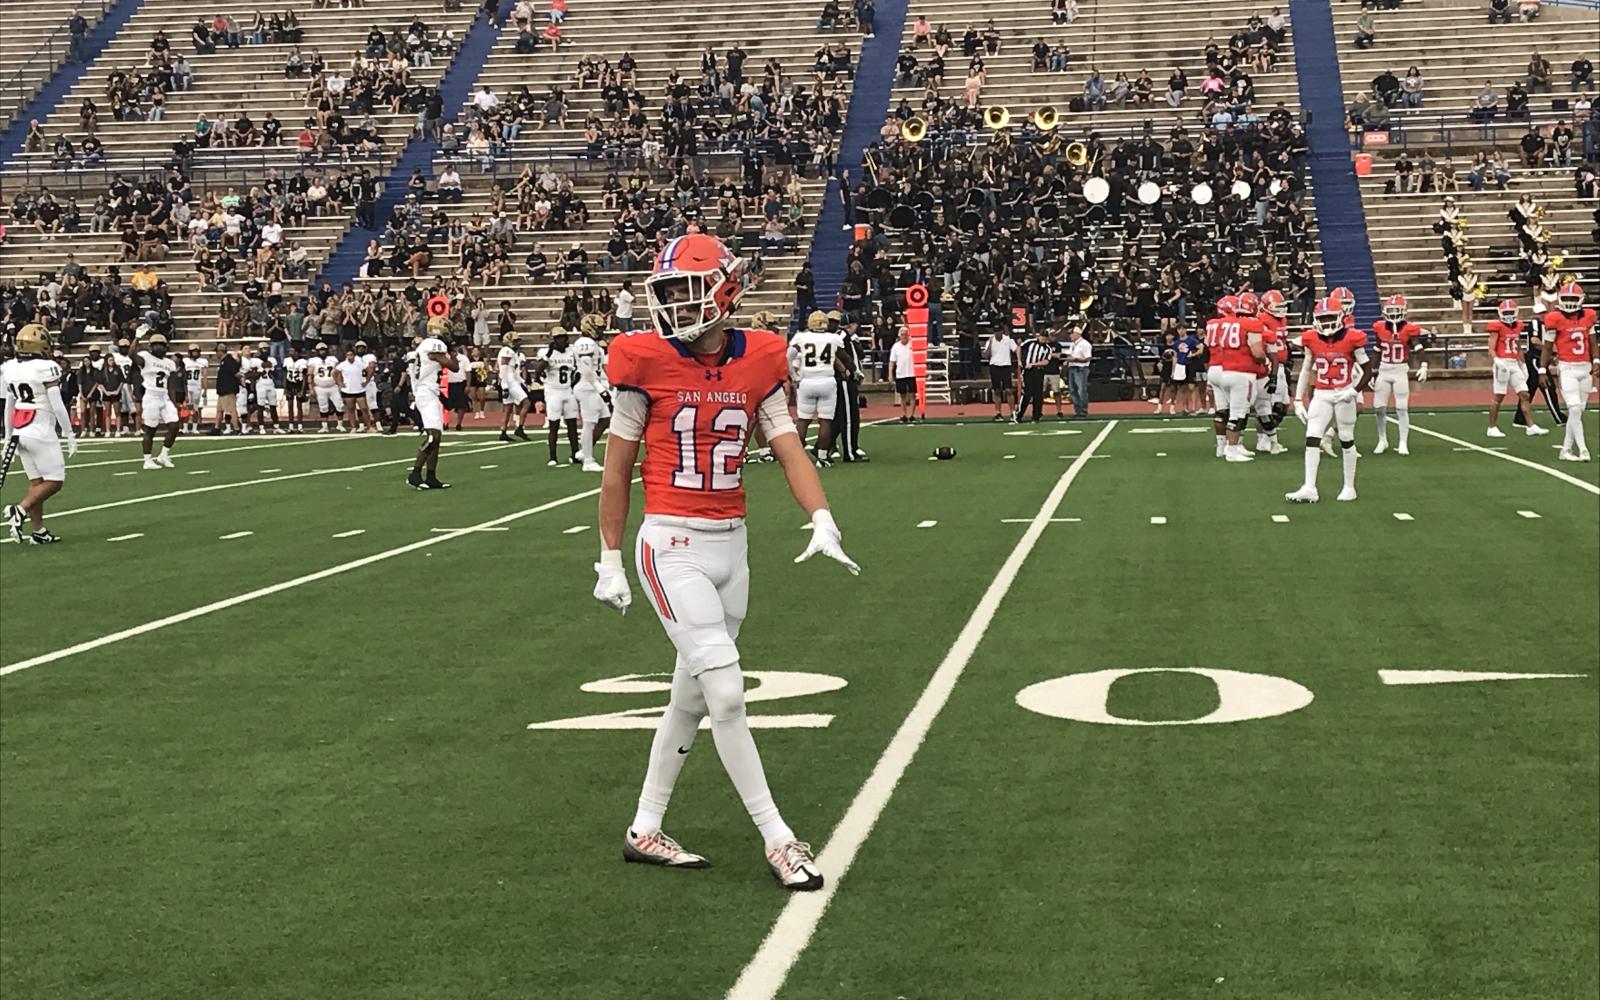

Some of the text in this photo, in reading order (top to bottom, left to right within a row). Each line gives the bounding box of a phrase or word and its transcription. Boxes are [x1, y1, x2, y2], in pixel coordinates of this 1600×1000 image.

[1012, 307, 1026, 326] 3
[1221, 322, 1241, 348] 78
[1571, 331, 1585, 355] 3
[804, 343, 832, 367] 24
[1380, 342, 1404, 363] 20
[156, 371, 166, 389] 2
[318, 367, 334, 379] 57
[559, 365, 570, 385] 6
[1312, 357, 1348, 385] 23
[677, 391, 747, 404] SAN ANGELO
[673, 405, 749, 491] 12
